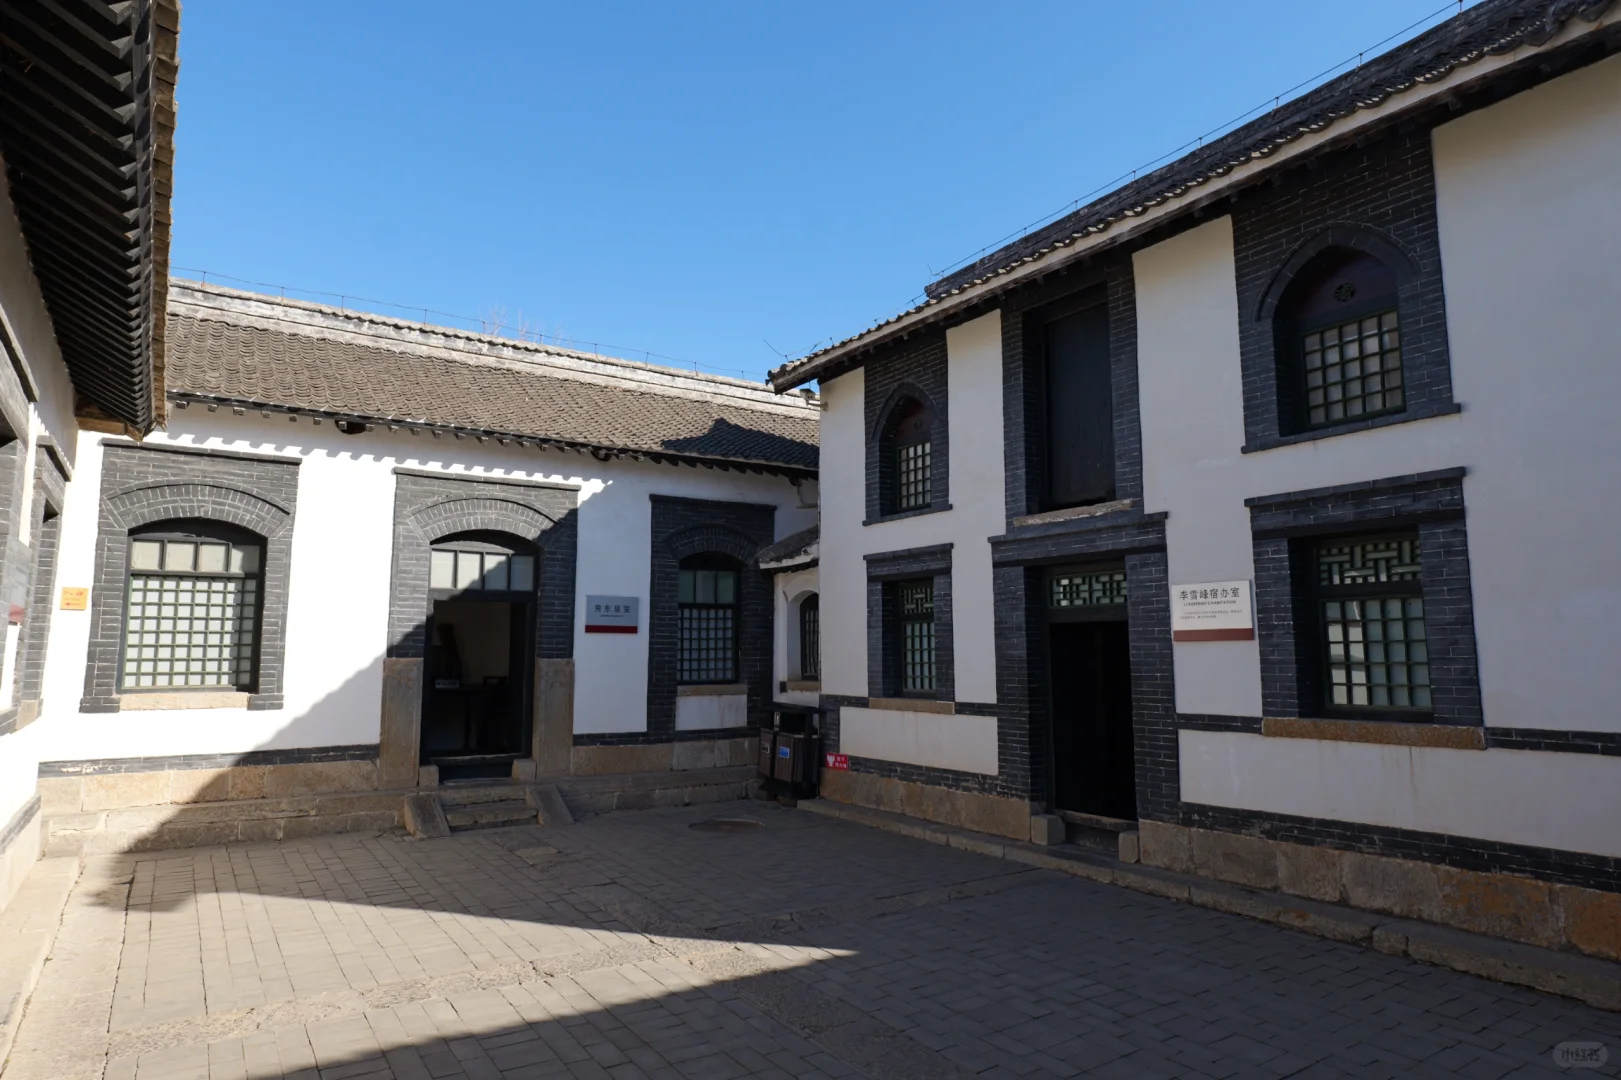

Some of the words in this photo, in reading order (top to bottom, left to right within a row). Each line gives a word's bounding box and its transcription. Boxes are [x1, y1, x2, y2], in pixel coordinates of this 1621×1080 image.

[1179, 587, 1240, 601] 李雪峰宿办室
